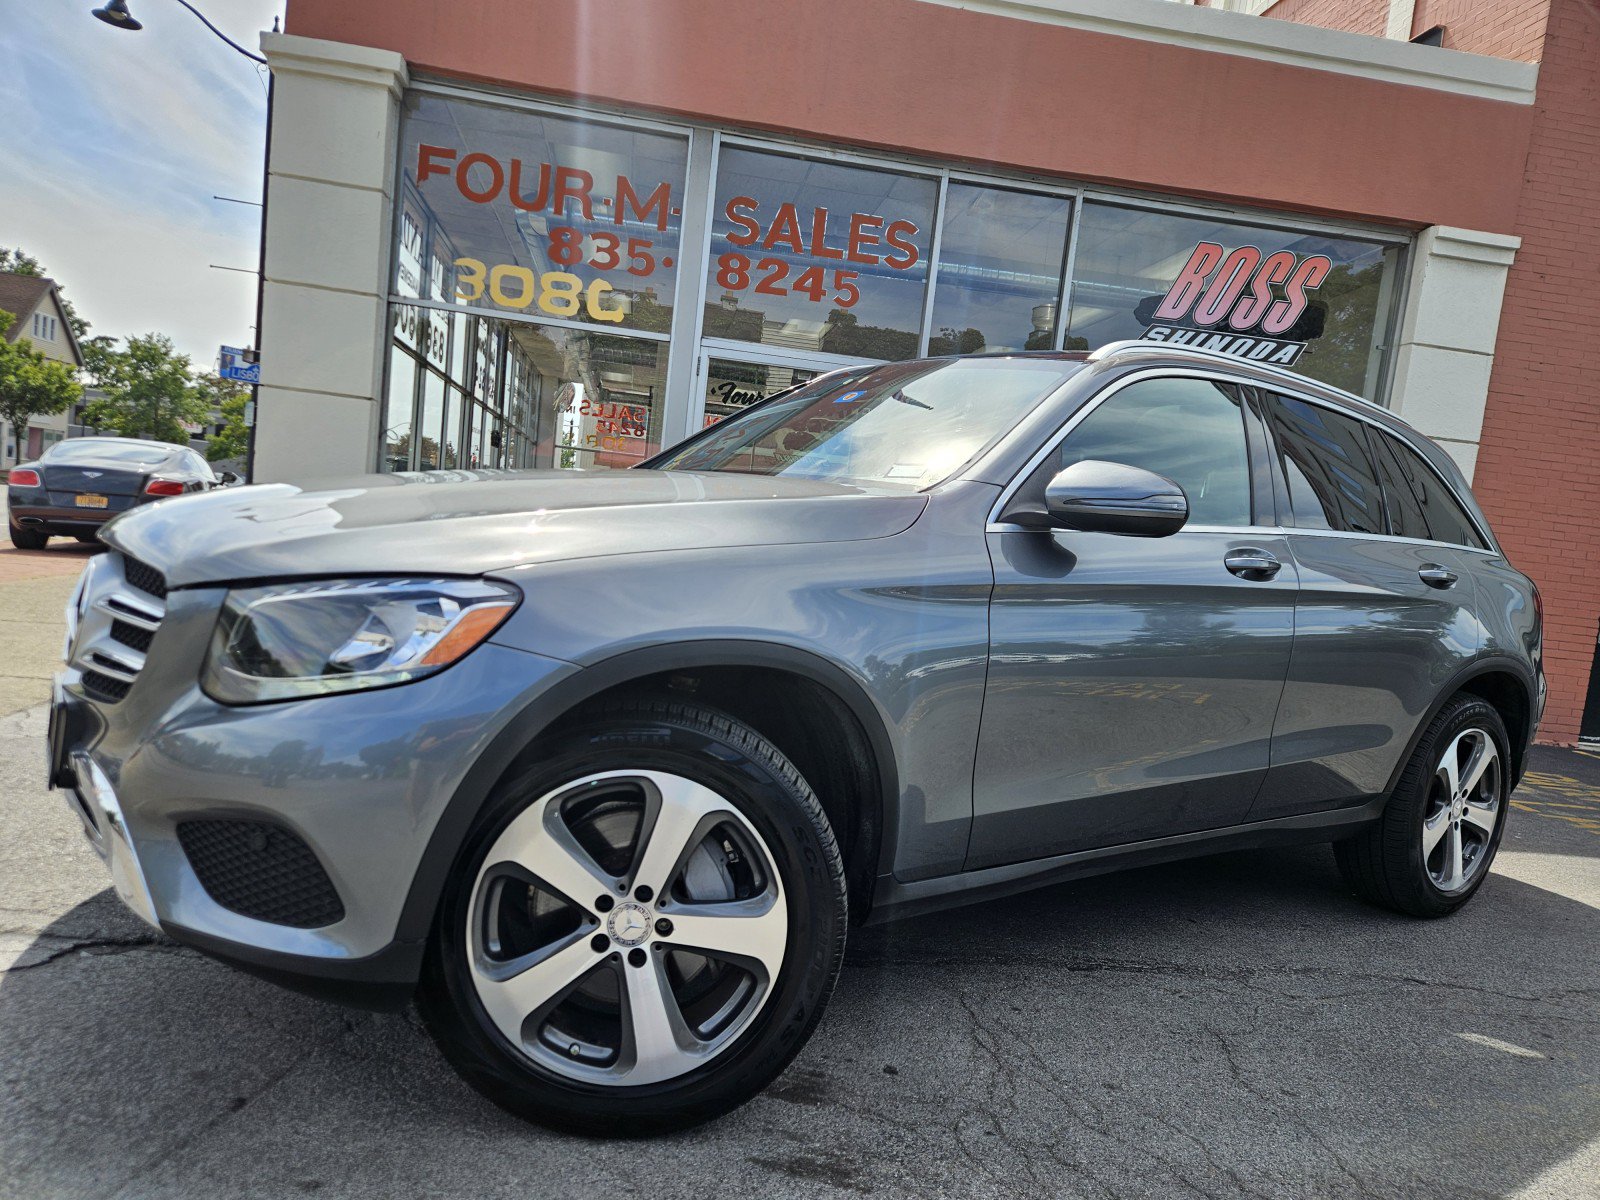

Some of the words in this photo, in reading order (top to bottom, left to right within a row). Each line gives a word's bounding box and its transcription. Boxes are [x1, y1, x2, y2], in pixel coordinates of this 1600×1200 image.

[726, 195, 919, 270] SALES
[716, 252, 860, 308] 8245
[1152, 240, 1332, 334] BOSS
[1143, 326, 1301, 364] SHINODA
